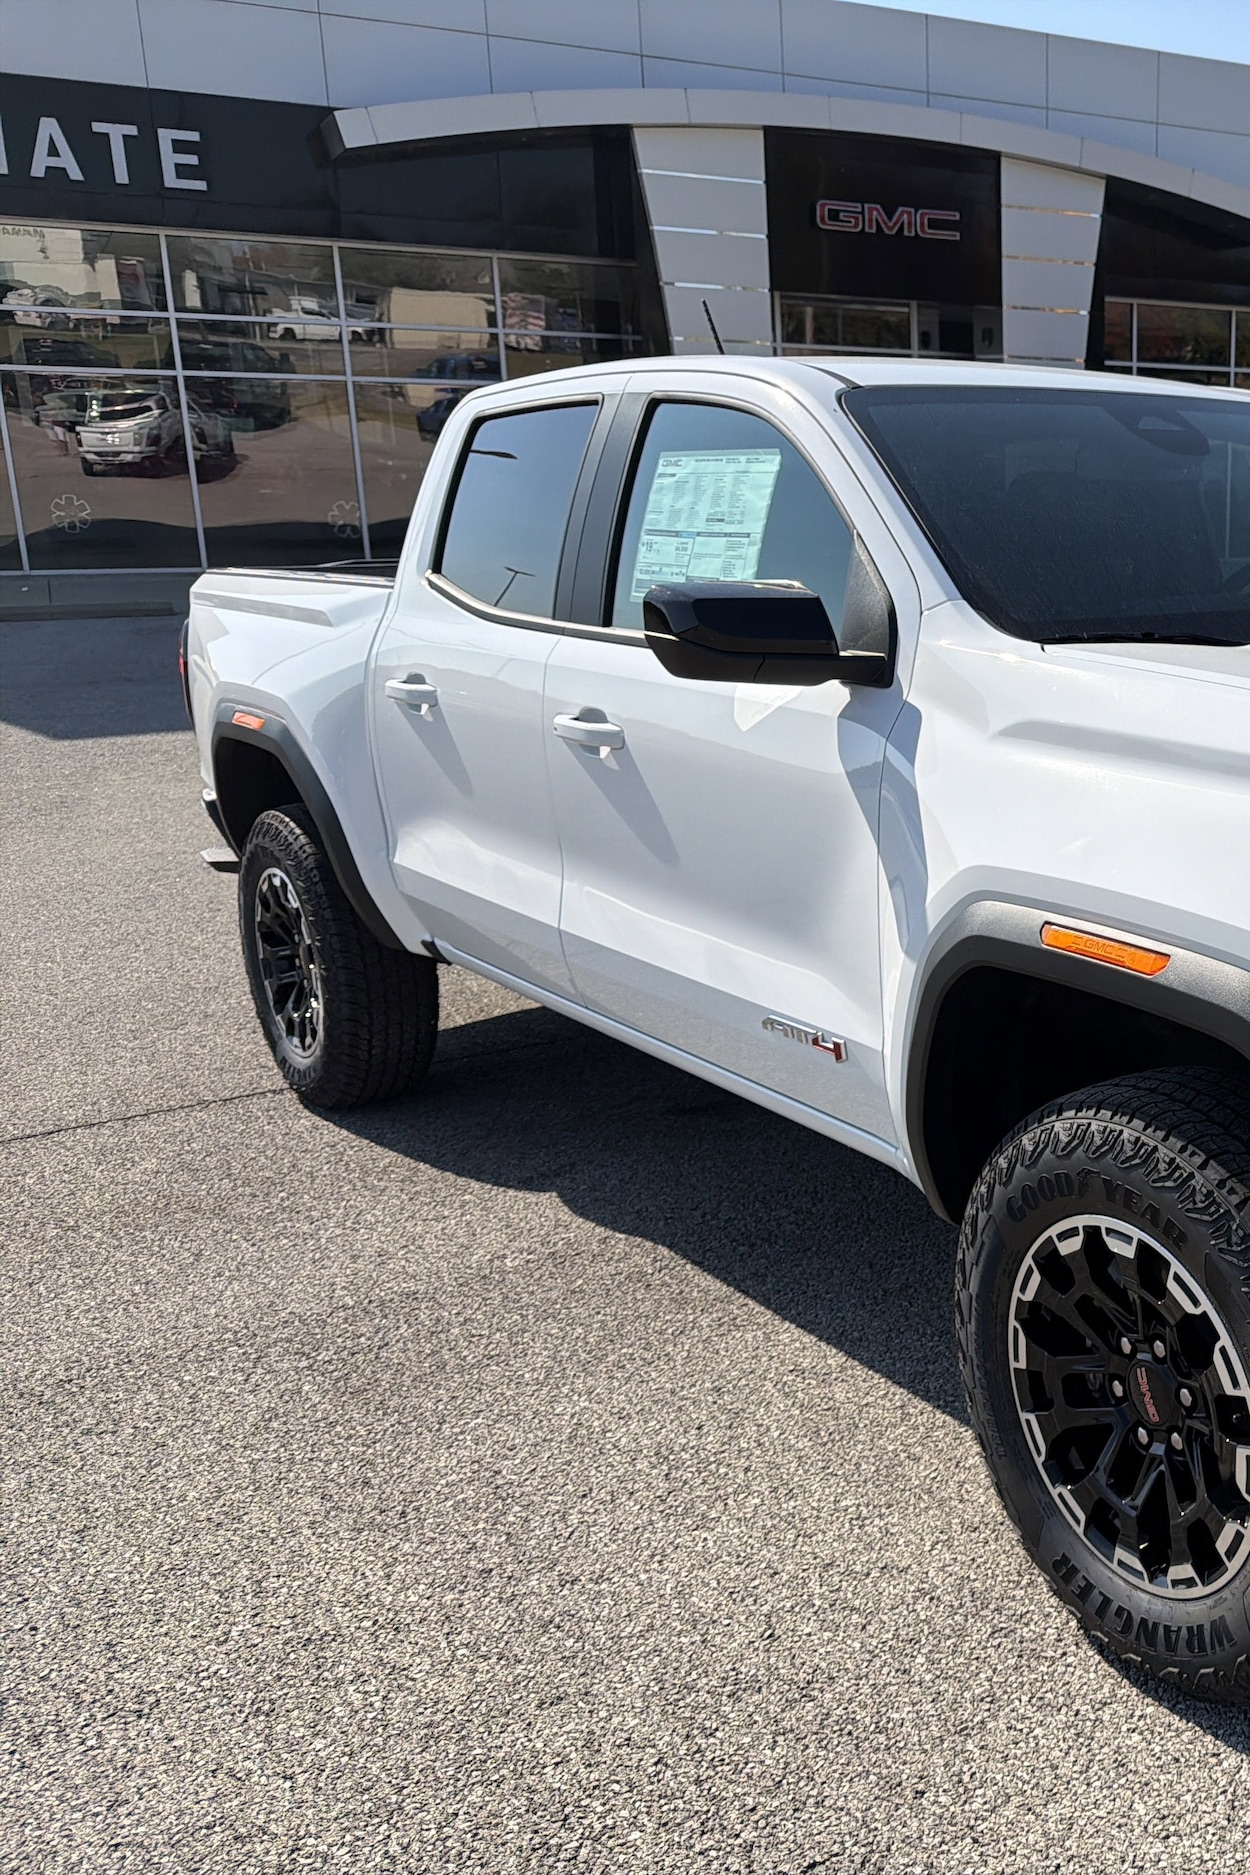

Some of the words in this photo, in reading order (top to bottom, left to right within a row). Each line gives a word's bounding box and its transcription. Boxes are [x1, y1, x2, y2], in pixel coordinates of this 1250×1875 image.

[816, 199, 960, 241] GMC
[661, 459, 683, 468] GMC
[1084, 941, 1115, 955] GMC
[762, 1014, 849, 1064] AT4
[1136, 1366, 1160, 1423] GMC
[1051, 1551, 1238, 1658] WRANGLER
